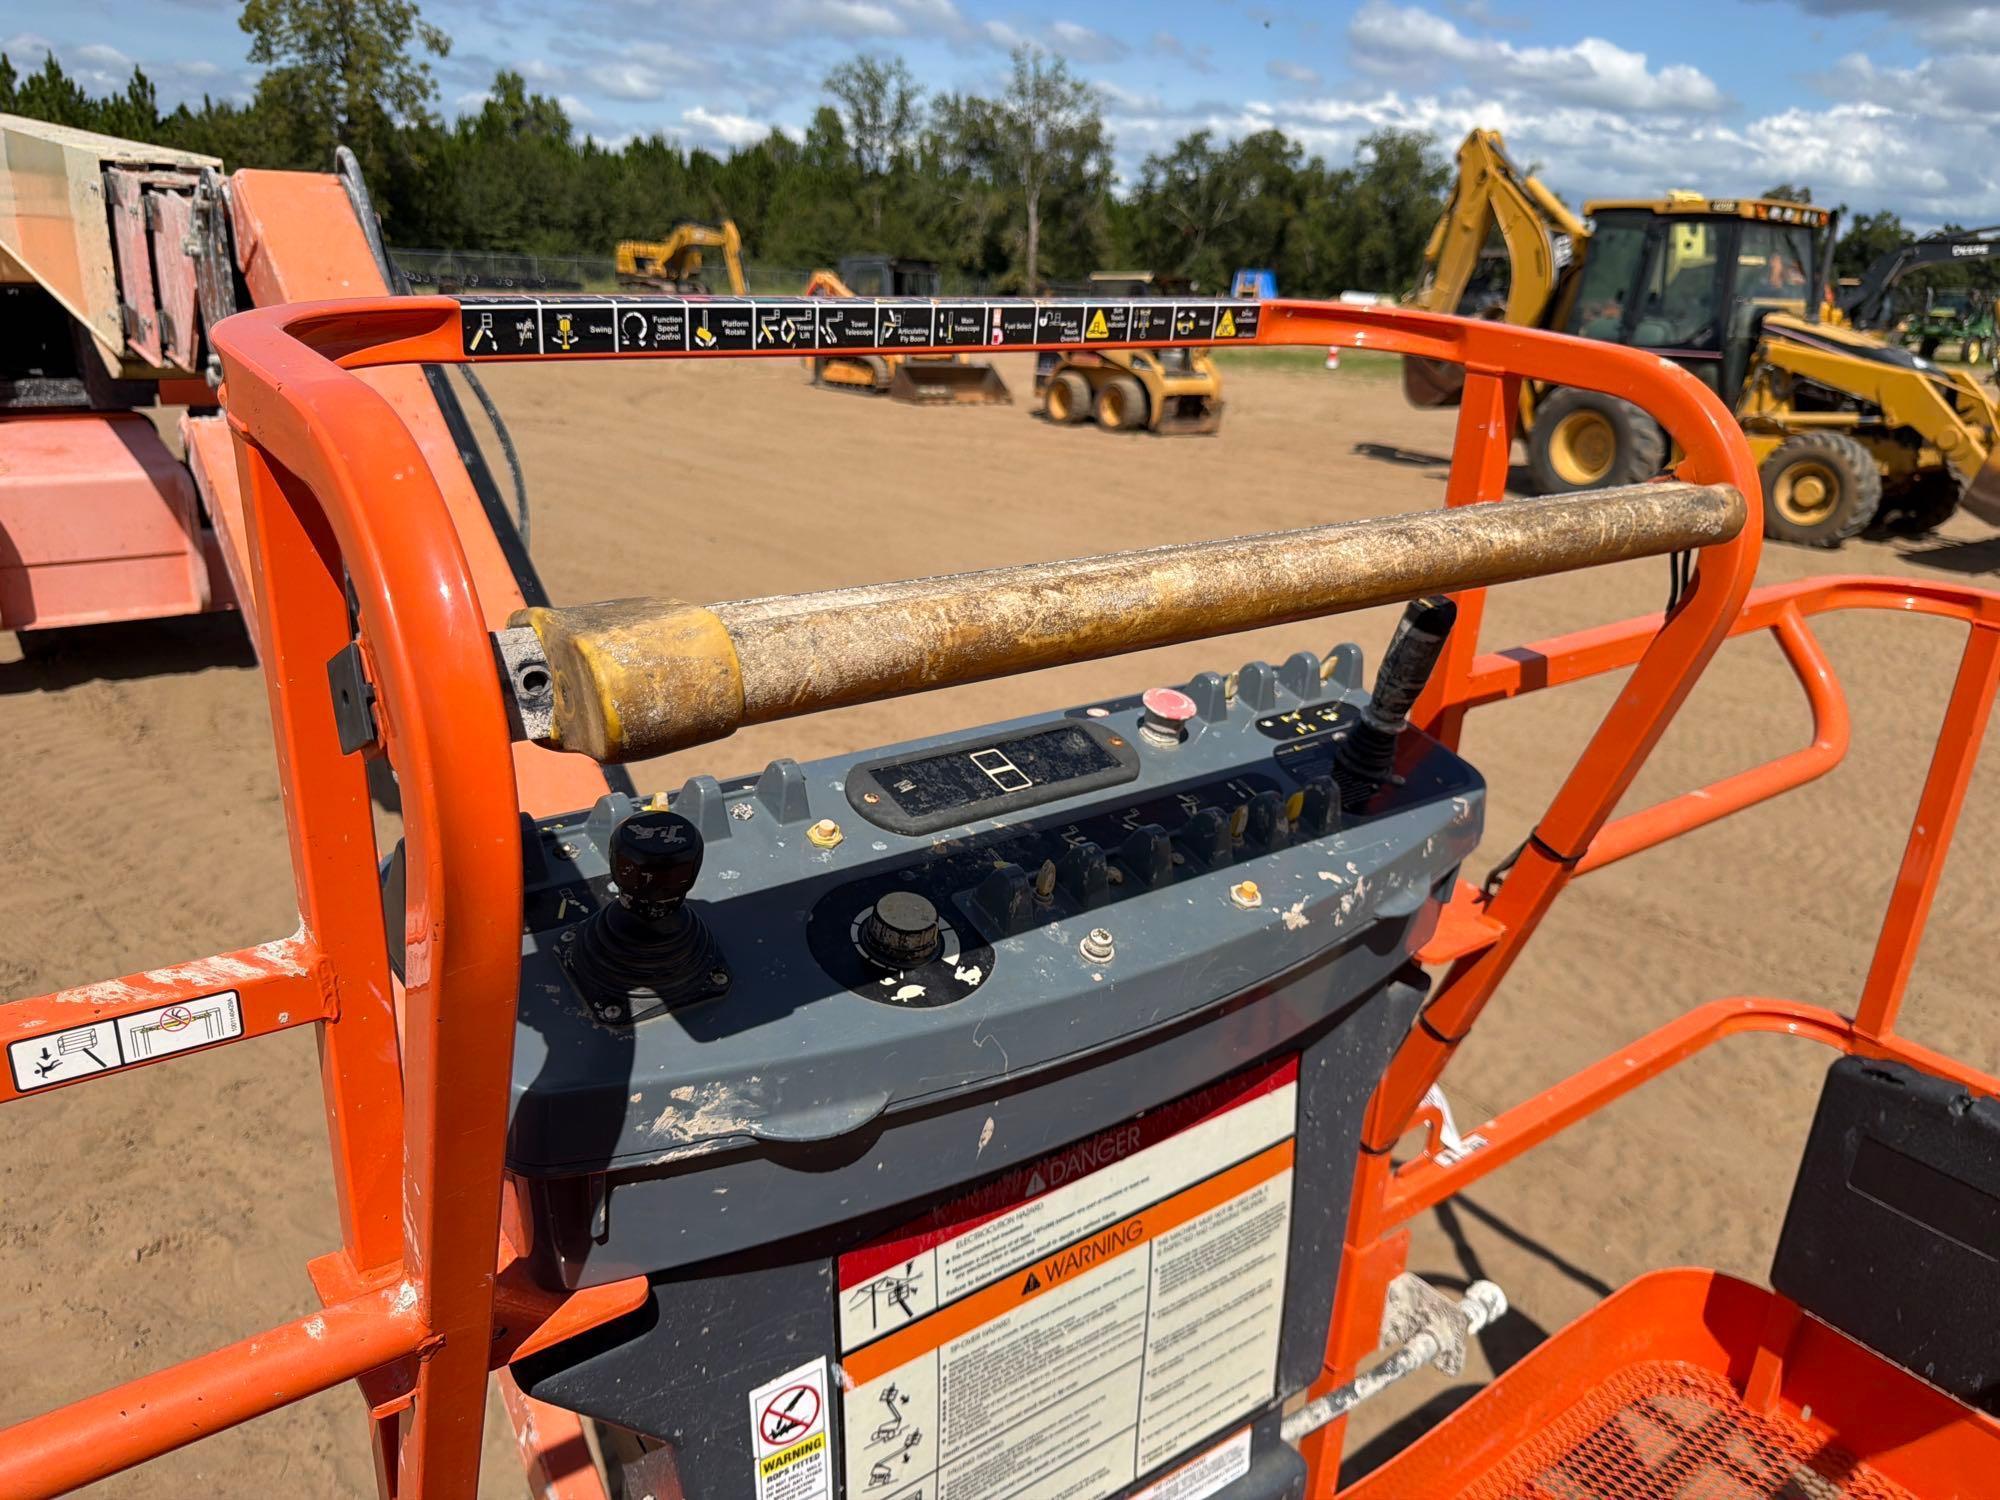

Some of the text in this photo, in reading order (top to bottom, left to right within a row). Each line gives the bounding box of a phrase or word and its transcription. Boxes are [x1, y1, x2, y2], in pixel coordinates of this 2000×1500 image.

[653, 316, 682, 324] Function
[722, 320, 749, 328] Platform
[516, 322, 534, 330] Mn
[590, 326, 612, 334] Swing
[658, 325, 678, 333] Speed
[954, 324, 980, 333] Telescope
[846, 328, 873, 336] Telescope
[898, 328, 929, 336] Articulating
[656, 333, 681, 341] Control
[1050, 1126, 1140, 1185] DANGER
[956, 1216, 1015, 1249] ELECTROCUTION
[1045, 1220, 1143, 1282] WARNING
[764, 1438, 821, 1473] WARNING
[767, 1452, 820, 1484] ROPS FITTED
